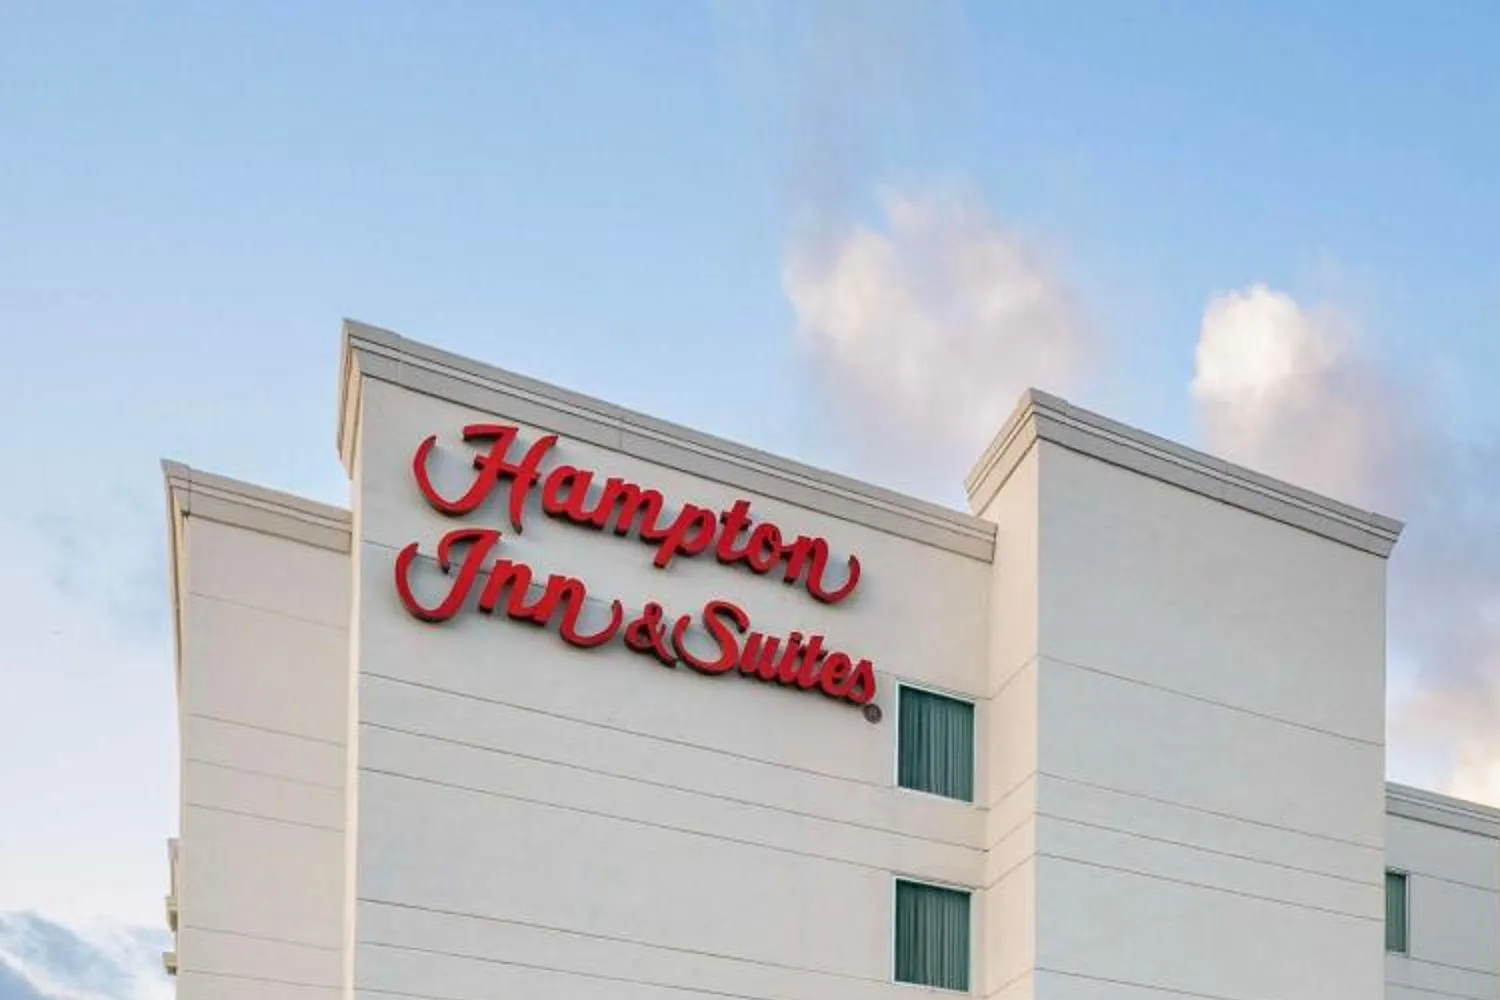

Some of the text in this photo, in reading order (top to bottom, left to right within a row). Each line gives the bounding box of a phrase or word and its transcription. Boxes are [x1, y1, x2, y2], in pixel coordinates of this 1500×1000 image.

[411, 423, 862, 605] Hampton
[395, 528, 878, 706] Inn & Suites
